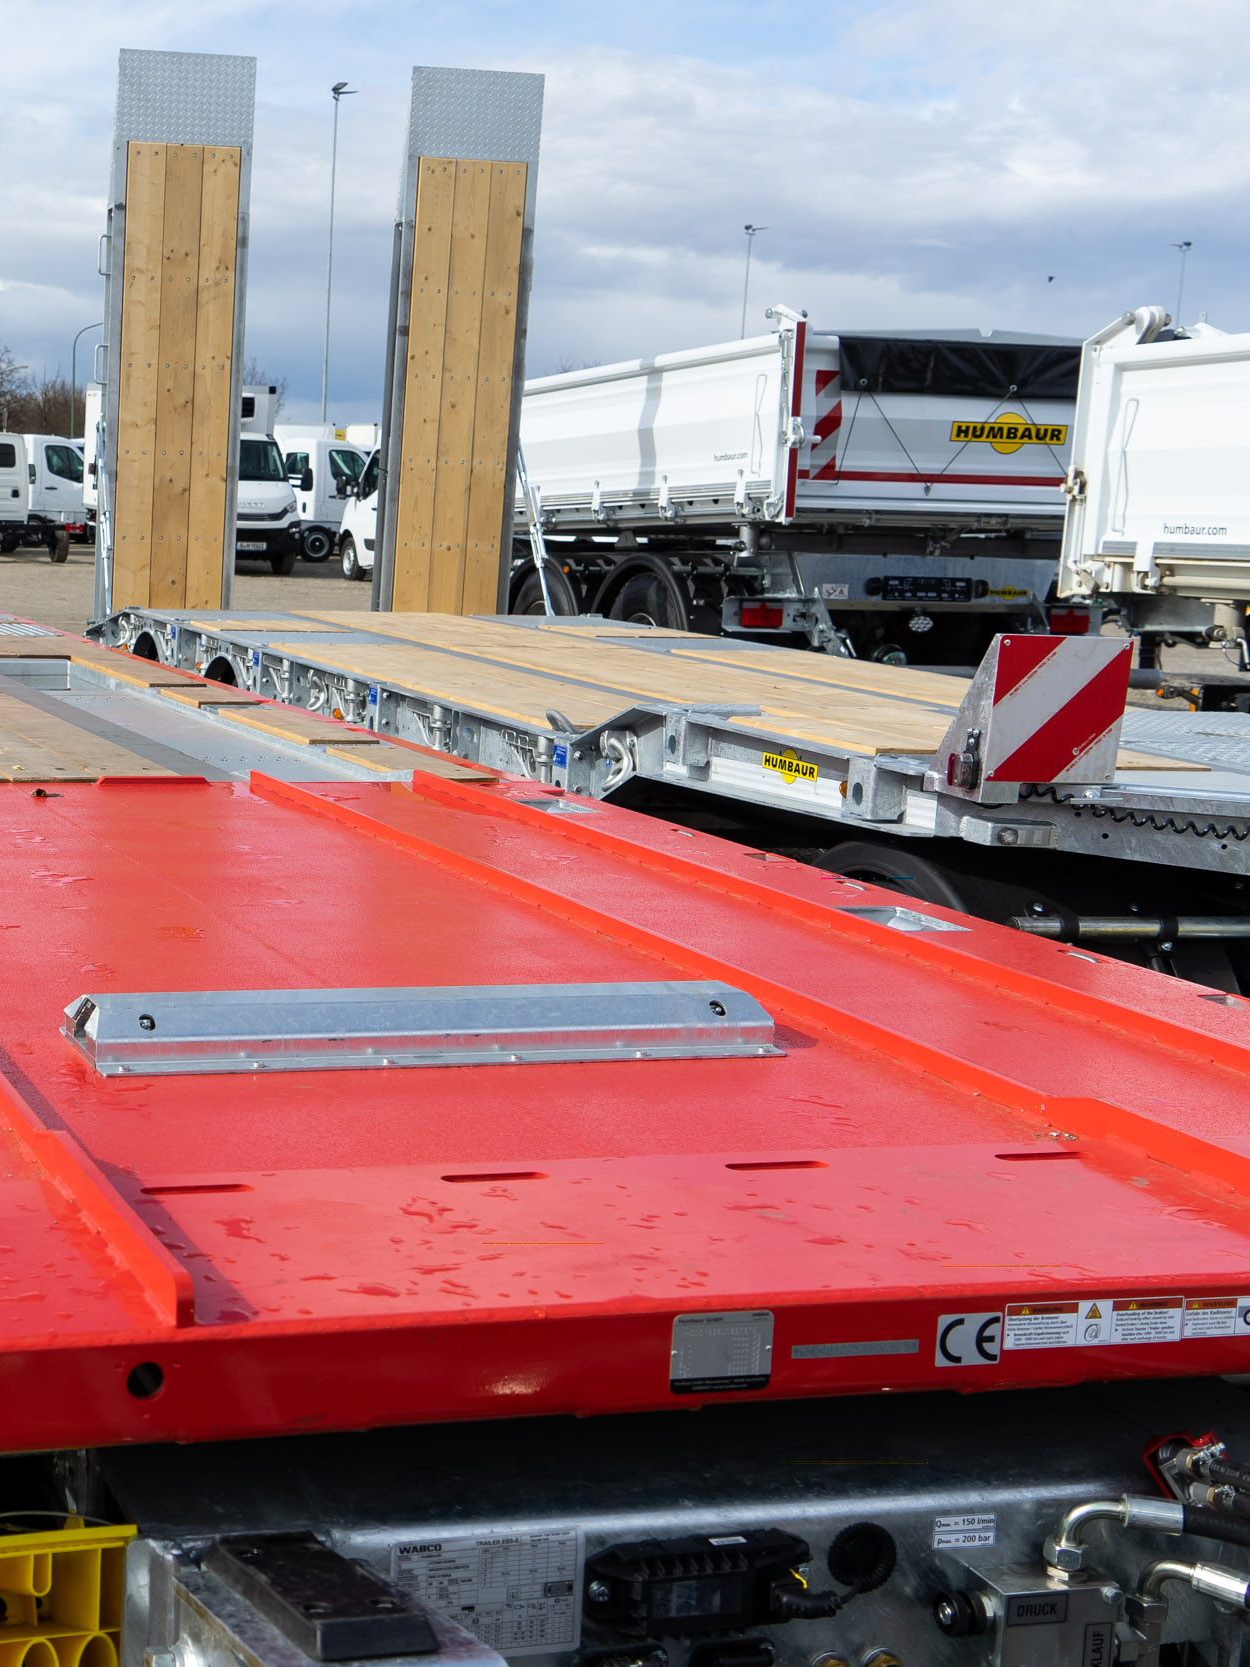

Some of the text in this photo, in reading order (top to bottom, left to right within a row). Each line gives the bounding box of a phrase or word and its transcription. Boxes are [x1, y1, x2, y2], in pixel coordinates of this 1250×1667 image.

[955, 425, 1062, 441] HUMBAUR
[1163, 522, 1228, 536] humbaur.com
[764, 754, 815, 778] HUMBAUR
[961, 1517, 976, 1526] 150
[962, 1535, 977, 1543] 200
[978, 1534, 991, 1542] bar
[398, 1543, 442, 1555] WABCO
[1016, 1602, 1058, 1618] DRUCK
